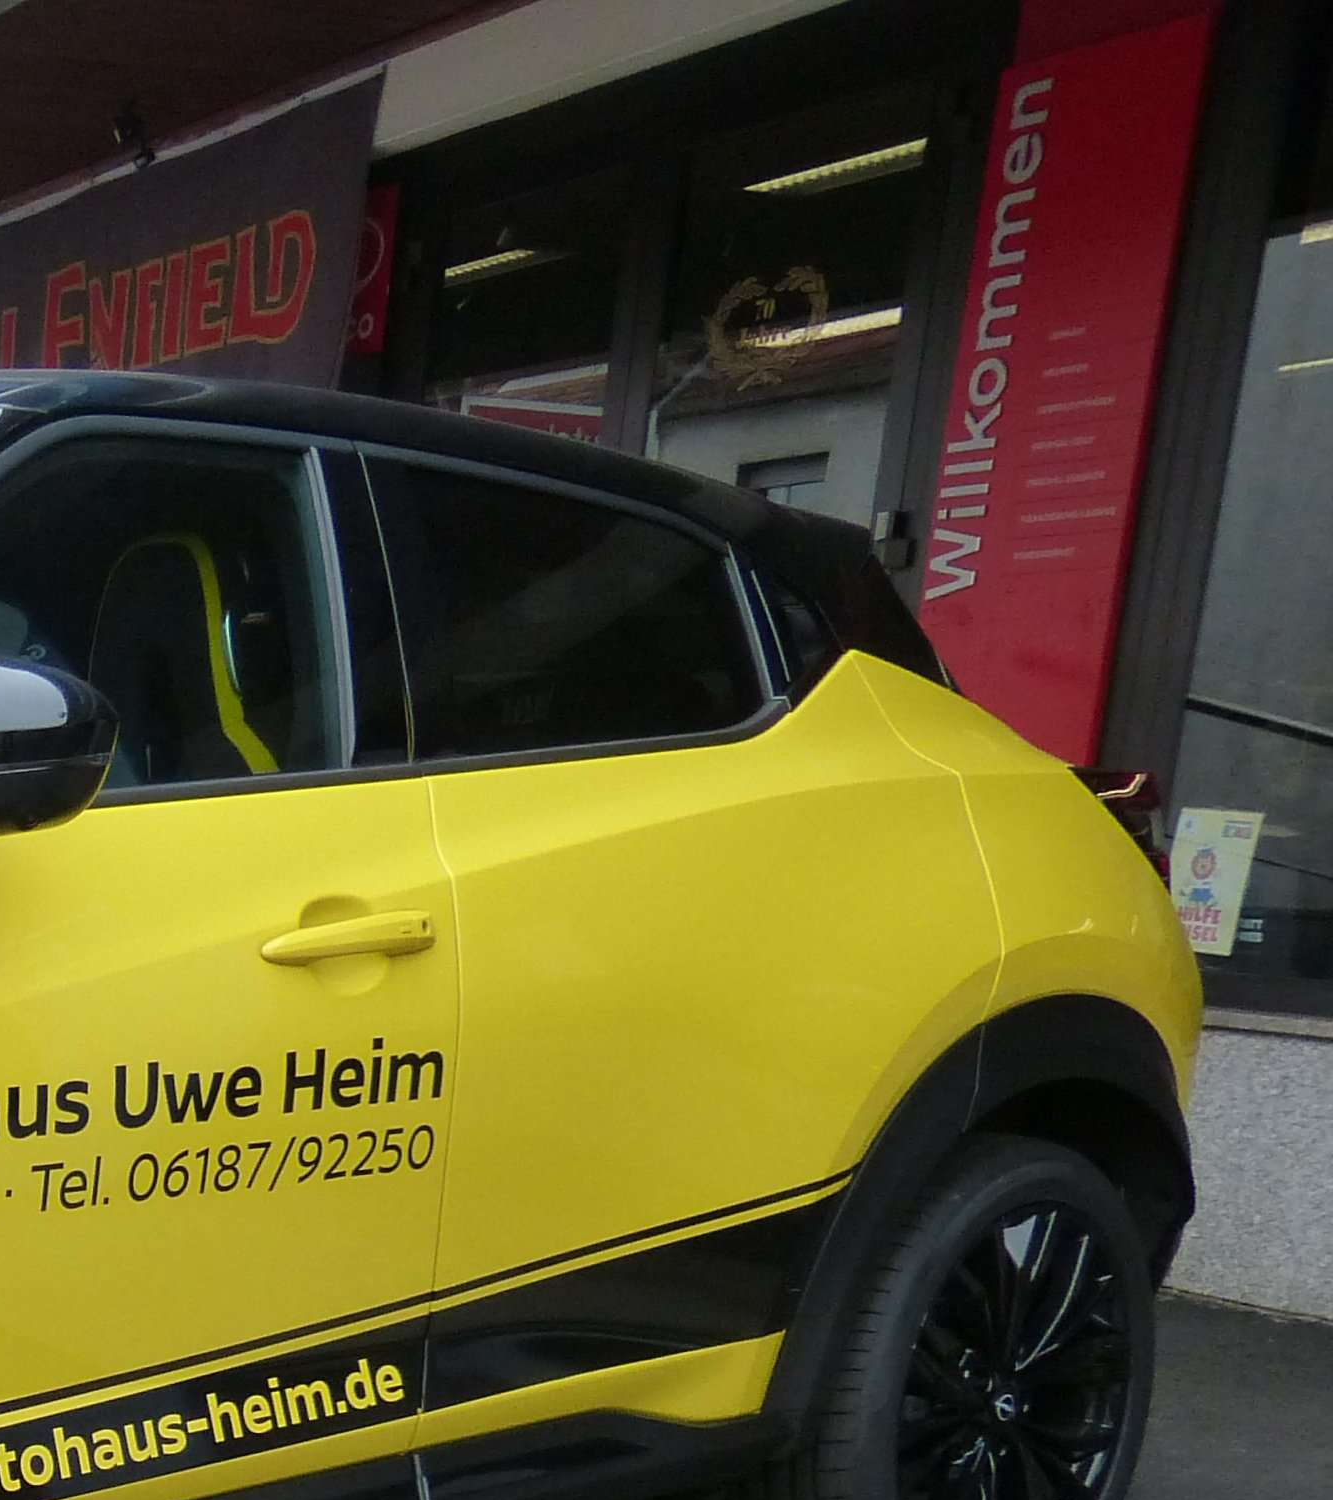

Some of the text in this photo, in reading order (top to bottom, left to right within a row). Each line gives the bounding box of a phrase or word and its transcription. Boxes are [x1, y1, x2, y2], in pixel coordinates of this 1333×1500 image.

[41, 209, 316, 371] ENFIELD
[925, 76, 1055, 601] Willkommen
[114, 1061, 263, 1129] Uwe
[282, 1037, 444, 1114] Heim
[31, 1155, 110, 1212] Tel.
[128, 1124, 435, 1202] 06187/92250
